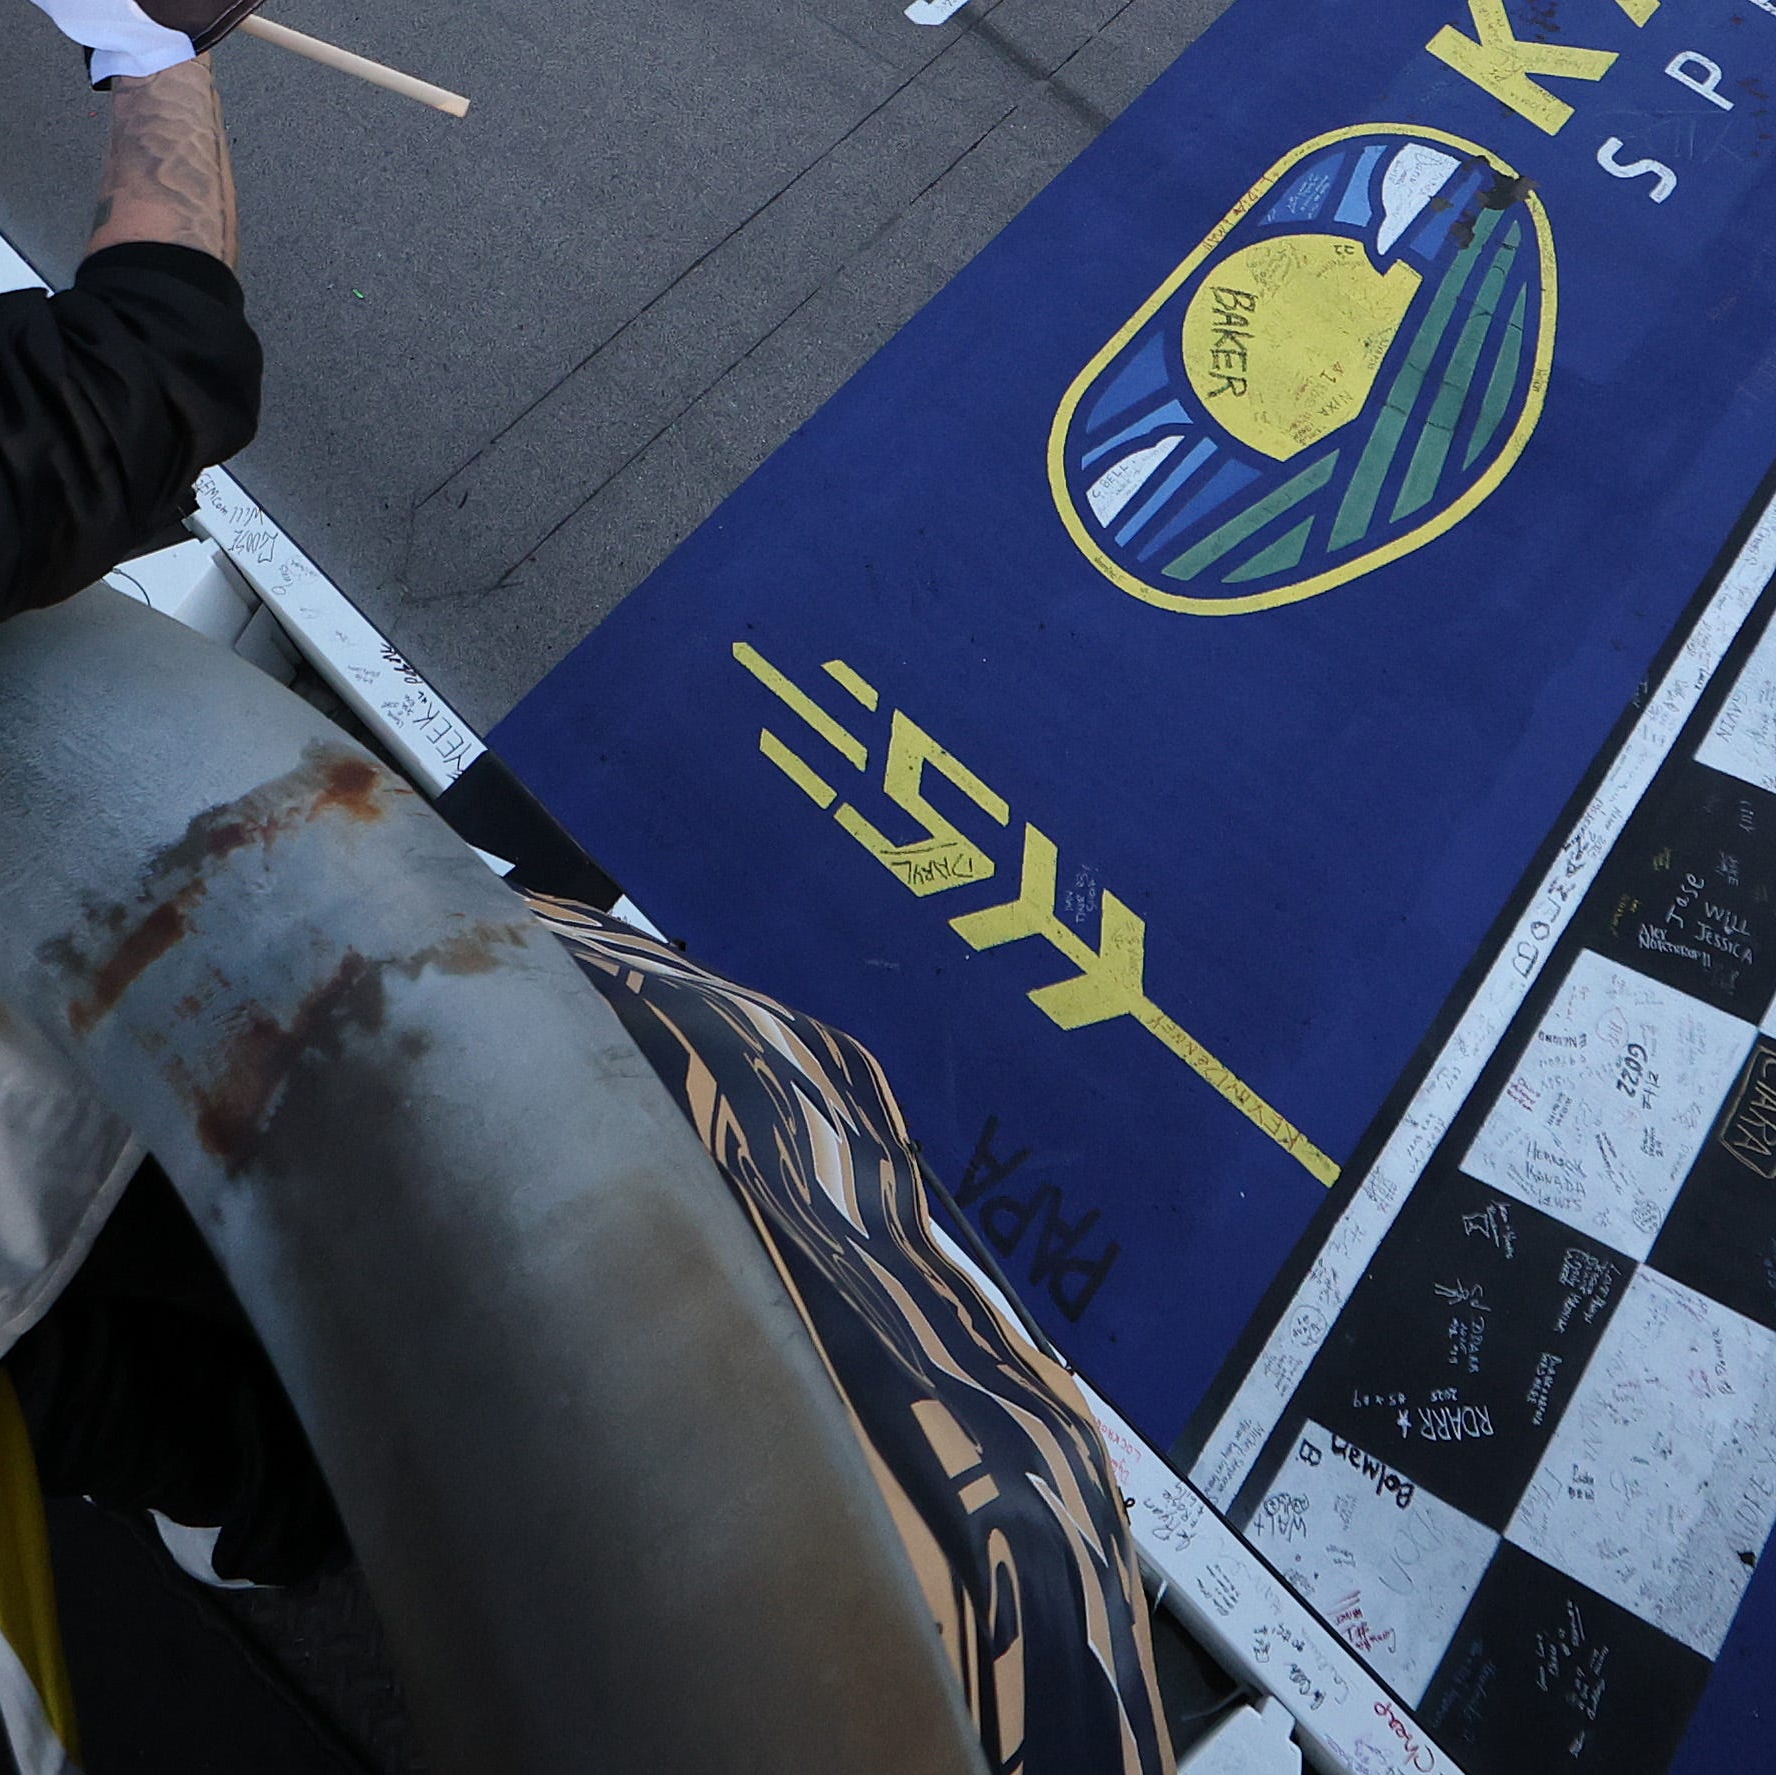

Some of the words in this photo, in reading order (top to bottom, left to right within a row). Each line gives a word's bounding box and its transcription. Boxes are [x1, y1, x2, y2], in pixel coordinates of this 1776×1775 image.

[1208, 285, 1258, 401] BAKER
[892, 855, 973, 887] DARYL
[952, 1115, 1124, 1323] PAPA
